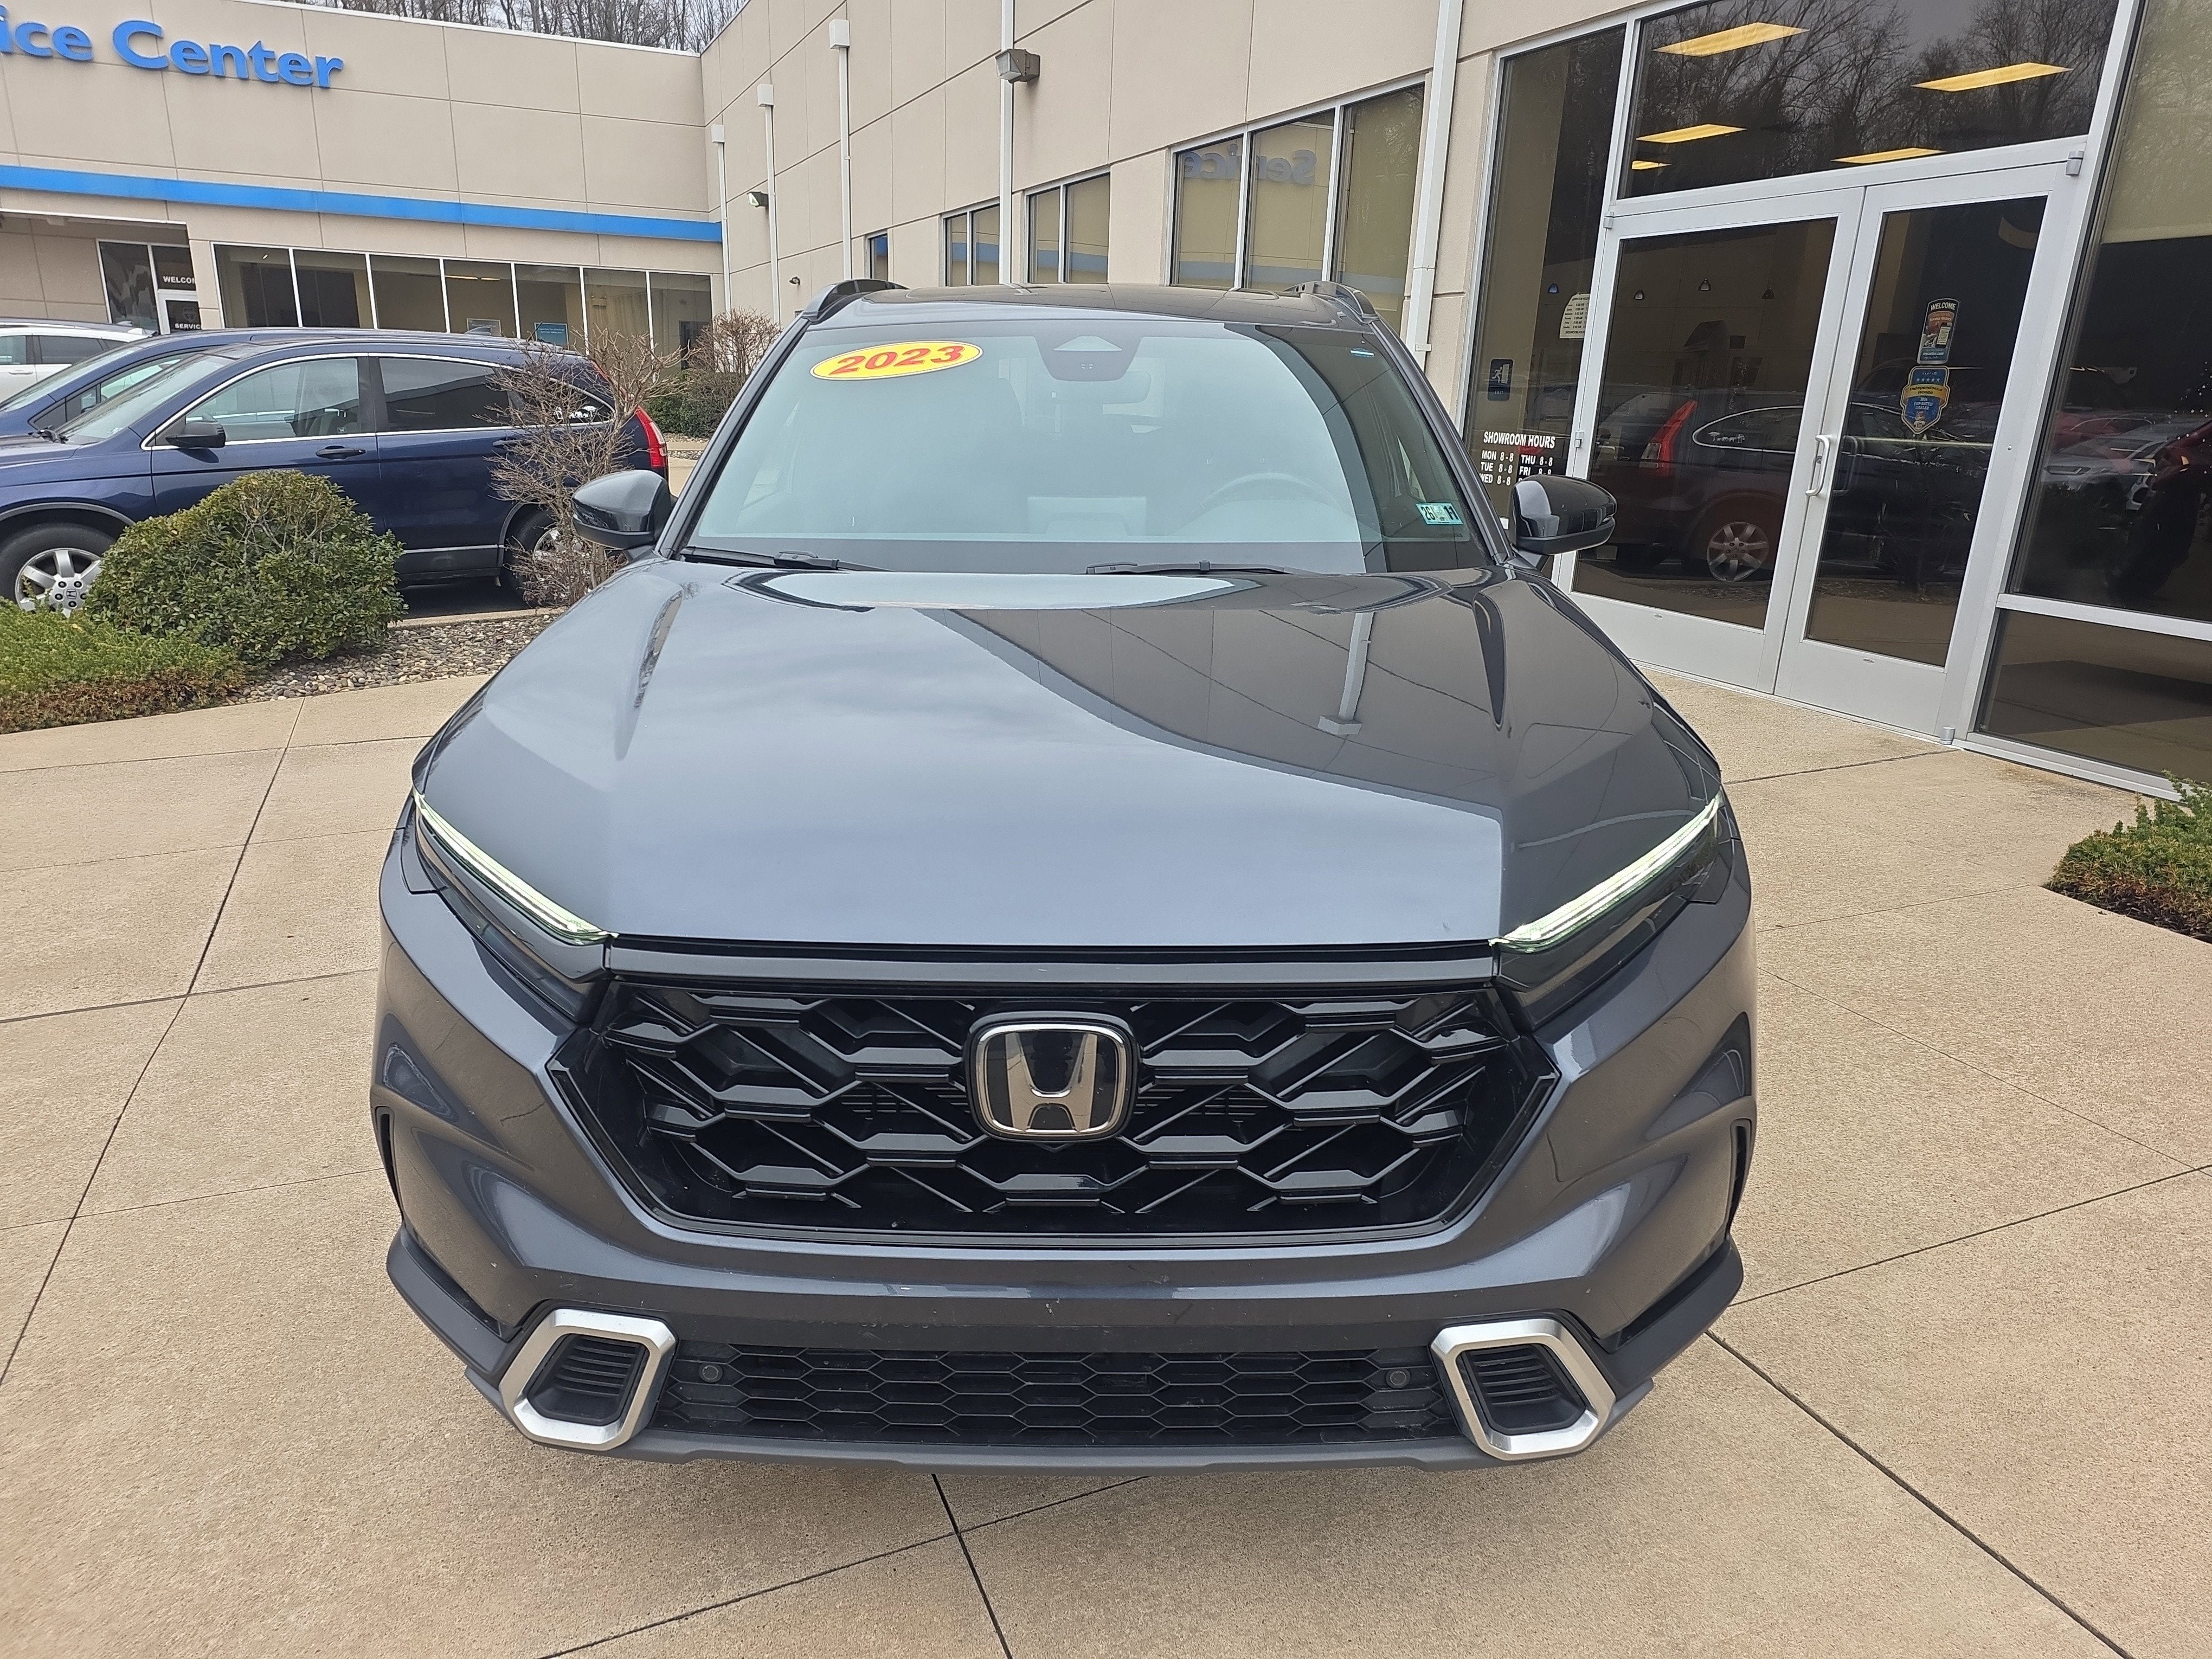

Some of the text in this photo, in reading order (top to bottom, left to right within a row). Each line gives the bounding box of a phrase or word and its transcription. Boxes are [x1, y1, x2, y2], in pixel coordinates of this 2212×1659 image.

[112, 20, 344, 88] Center
[1931, 302, 1957, 311] WELCOME
[828, 345, 965, 376] 2023
[1483, 431, 1555, 449] SHOWROOM HOURS
[1481, 450, 1497, 461] MON
[1521, 454, 1536, 465] THU
[1481, 461, 1494, 472] TUE
[1519, 466, 1531, 476] FRI
[1479, 473, 1493, 484] WED
[1420, 506, 1436, 520] 26
